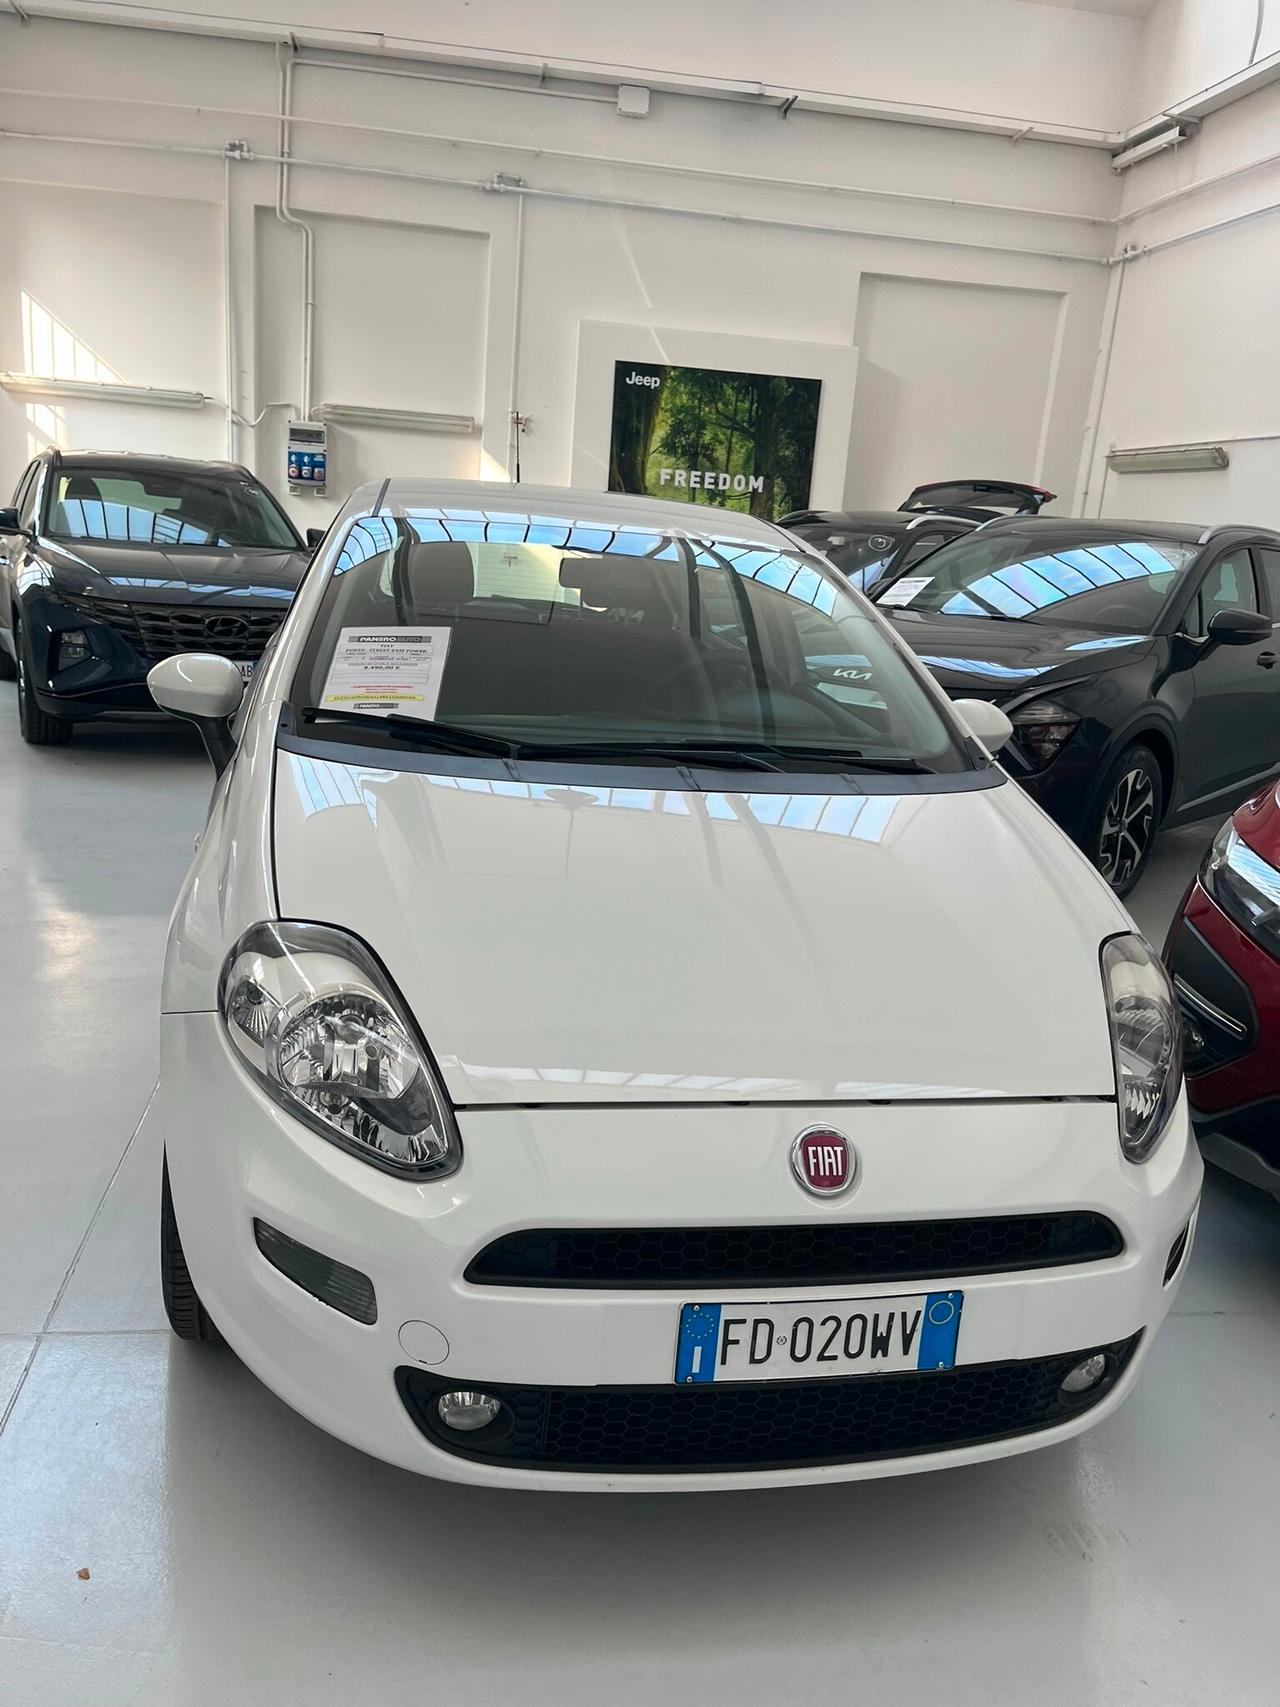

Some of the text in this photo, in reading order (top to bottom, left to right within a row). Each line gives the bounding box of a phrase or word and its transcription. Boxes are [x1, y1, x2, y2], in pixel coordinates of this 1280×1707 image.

[625, 371, 661, 390] Jeep
[659, 468, 765, 493] FREEDOM
[808, 1145, 844, 1177] FIAT
